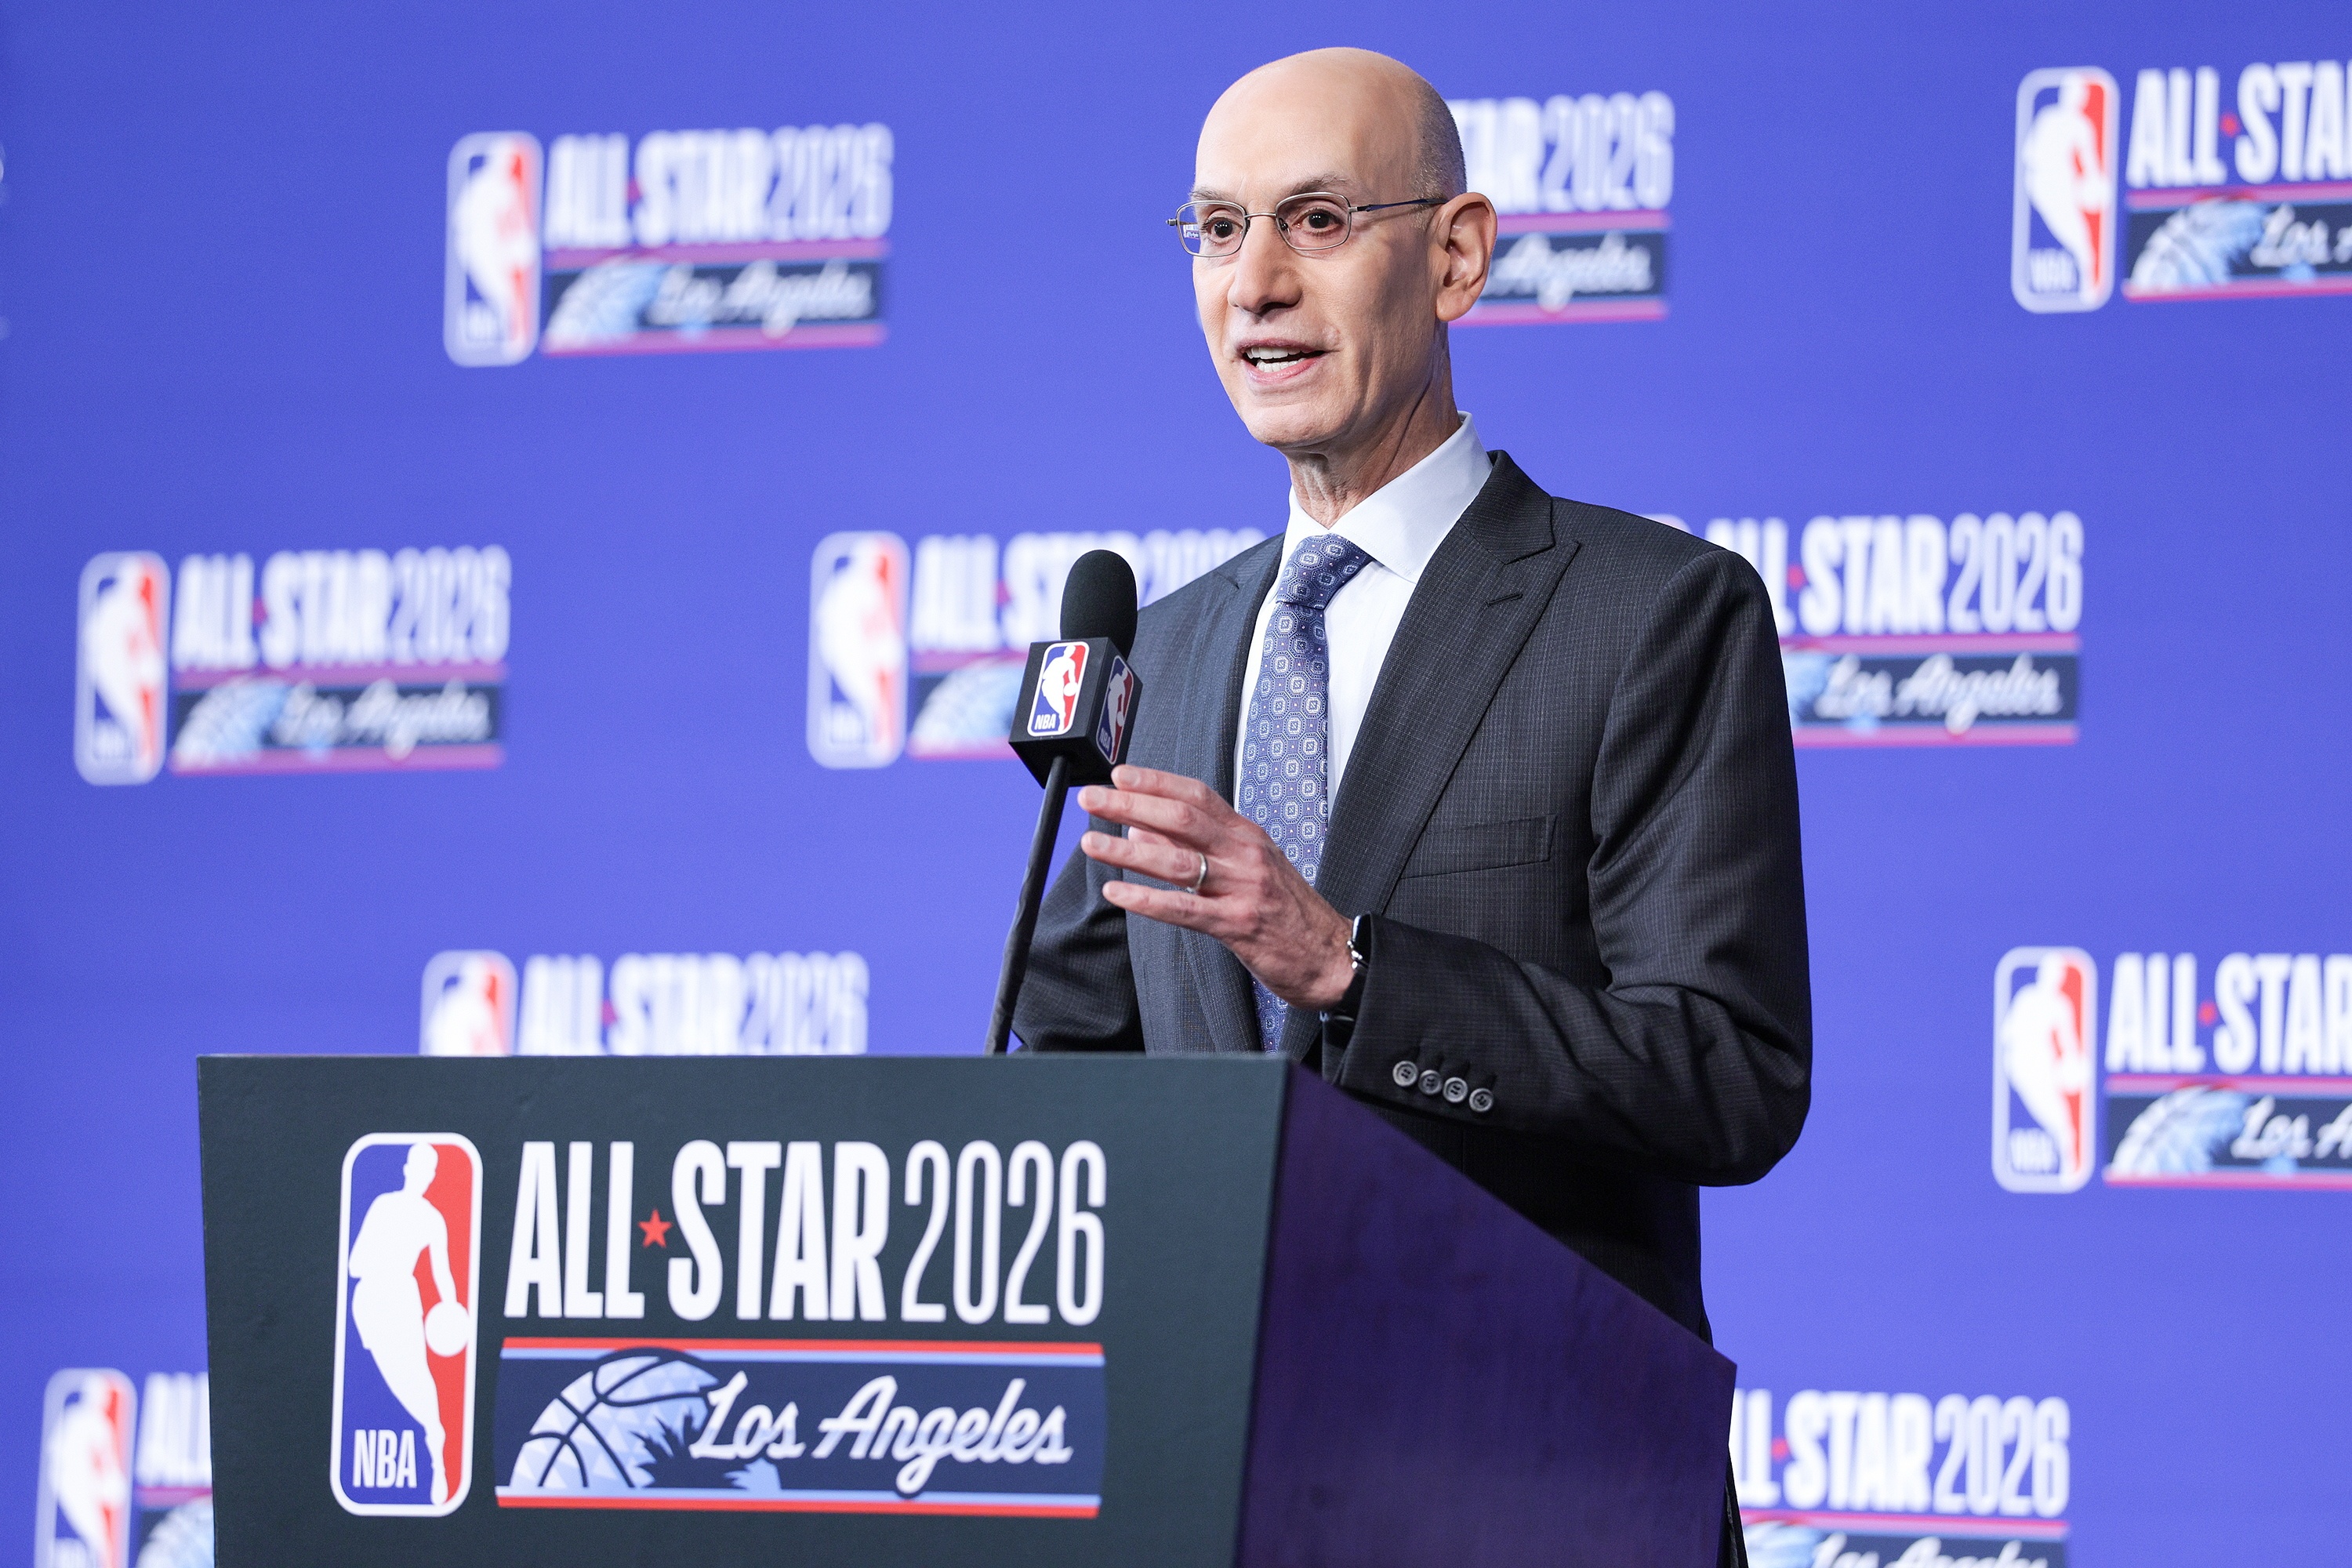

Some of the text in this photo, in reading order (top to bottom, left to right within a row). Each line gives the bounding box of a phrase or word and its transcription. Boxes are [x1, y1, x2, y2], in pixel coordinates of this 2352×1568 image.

[1539, 89, 1676, 212] 2026
[2126, 60, 2352, 188] ALL STA
[1798, 514, 1950, 637] STAR
[1946, 510, 2085, 634] 2026
[1033, 713, 1057, 731] NBA
[2104, 951, 2207, 1073] ALL
[503, 1138, 1107, 1327] ALL STAR 2026
[352, 1428, 417, 1489] NBA
[688, 1370, 1074, 1494] Los Angeles
[1783, 1388, 1933, 1512] STAR
[1933, 1392, 2071, 1519] 2026
